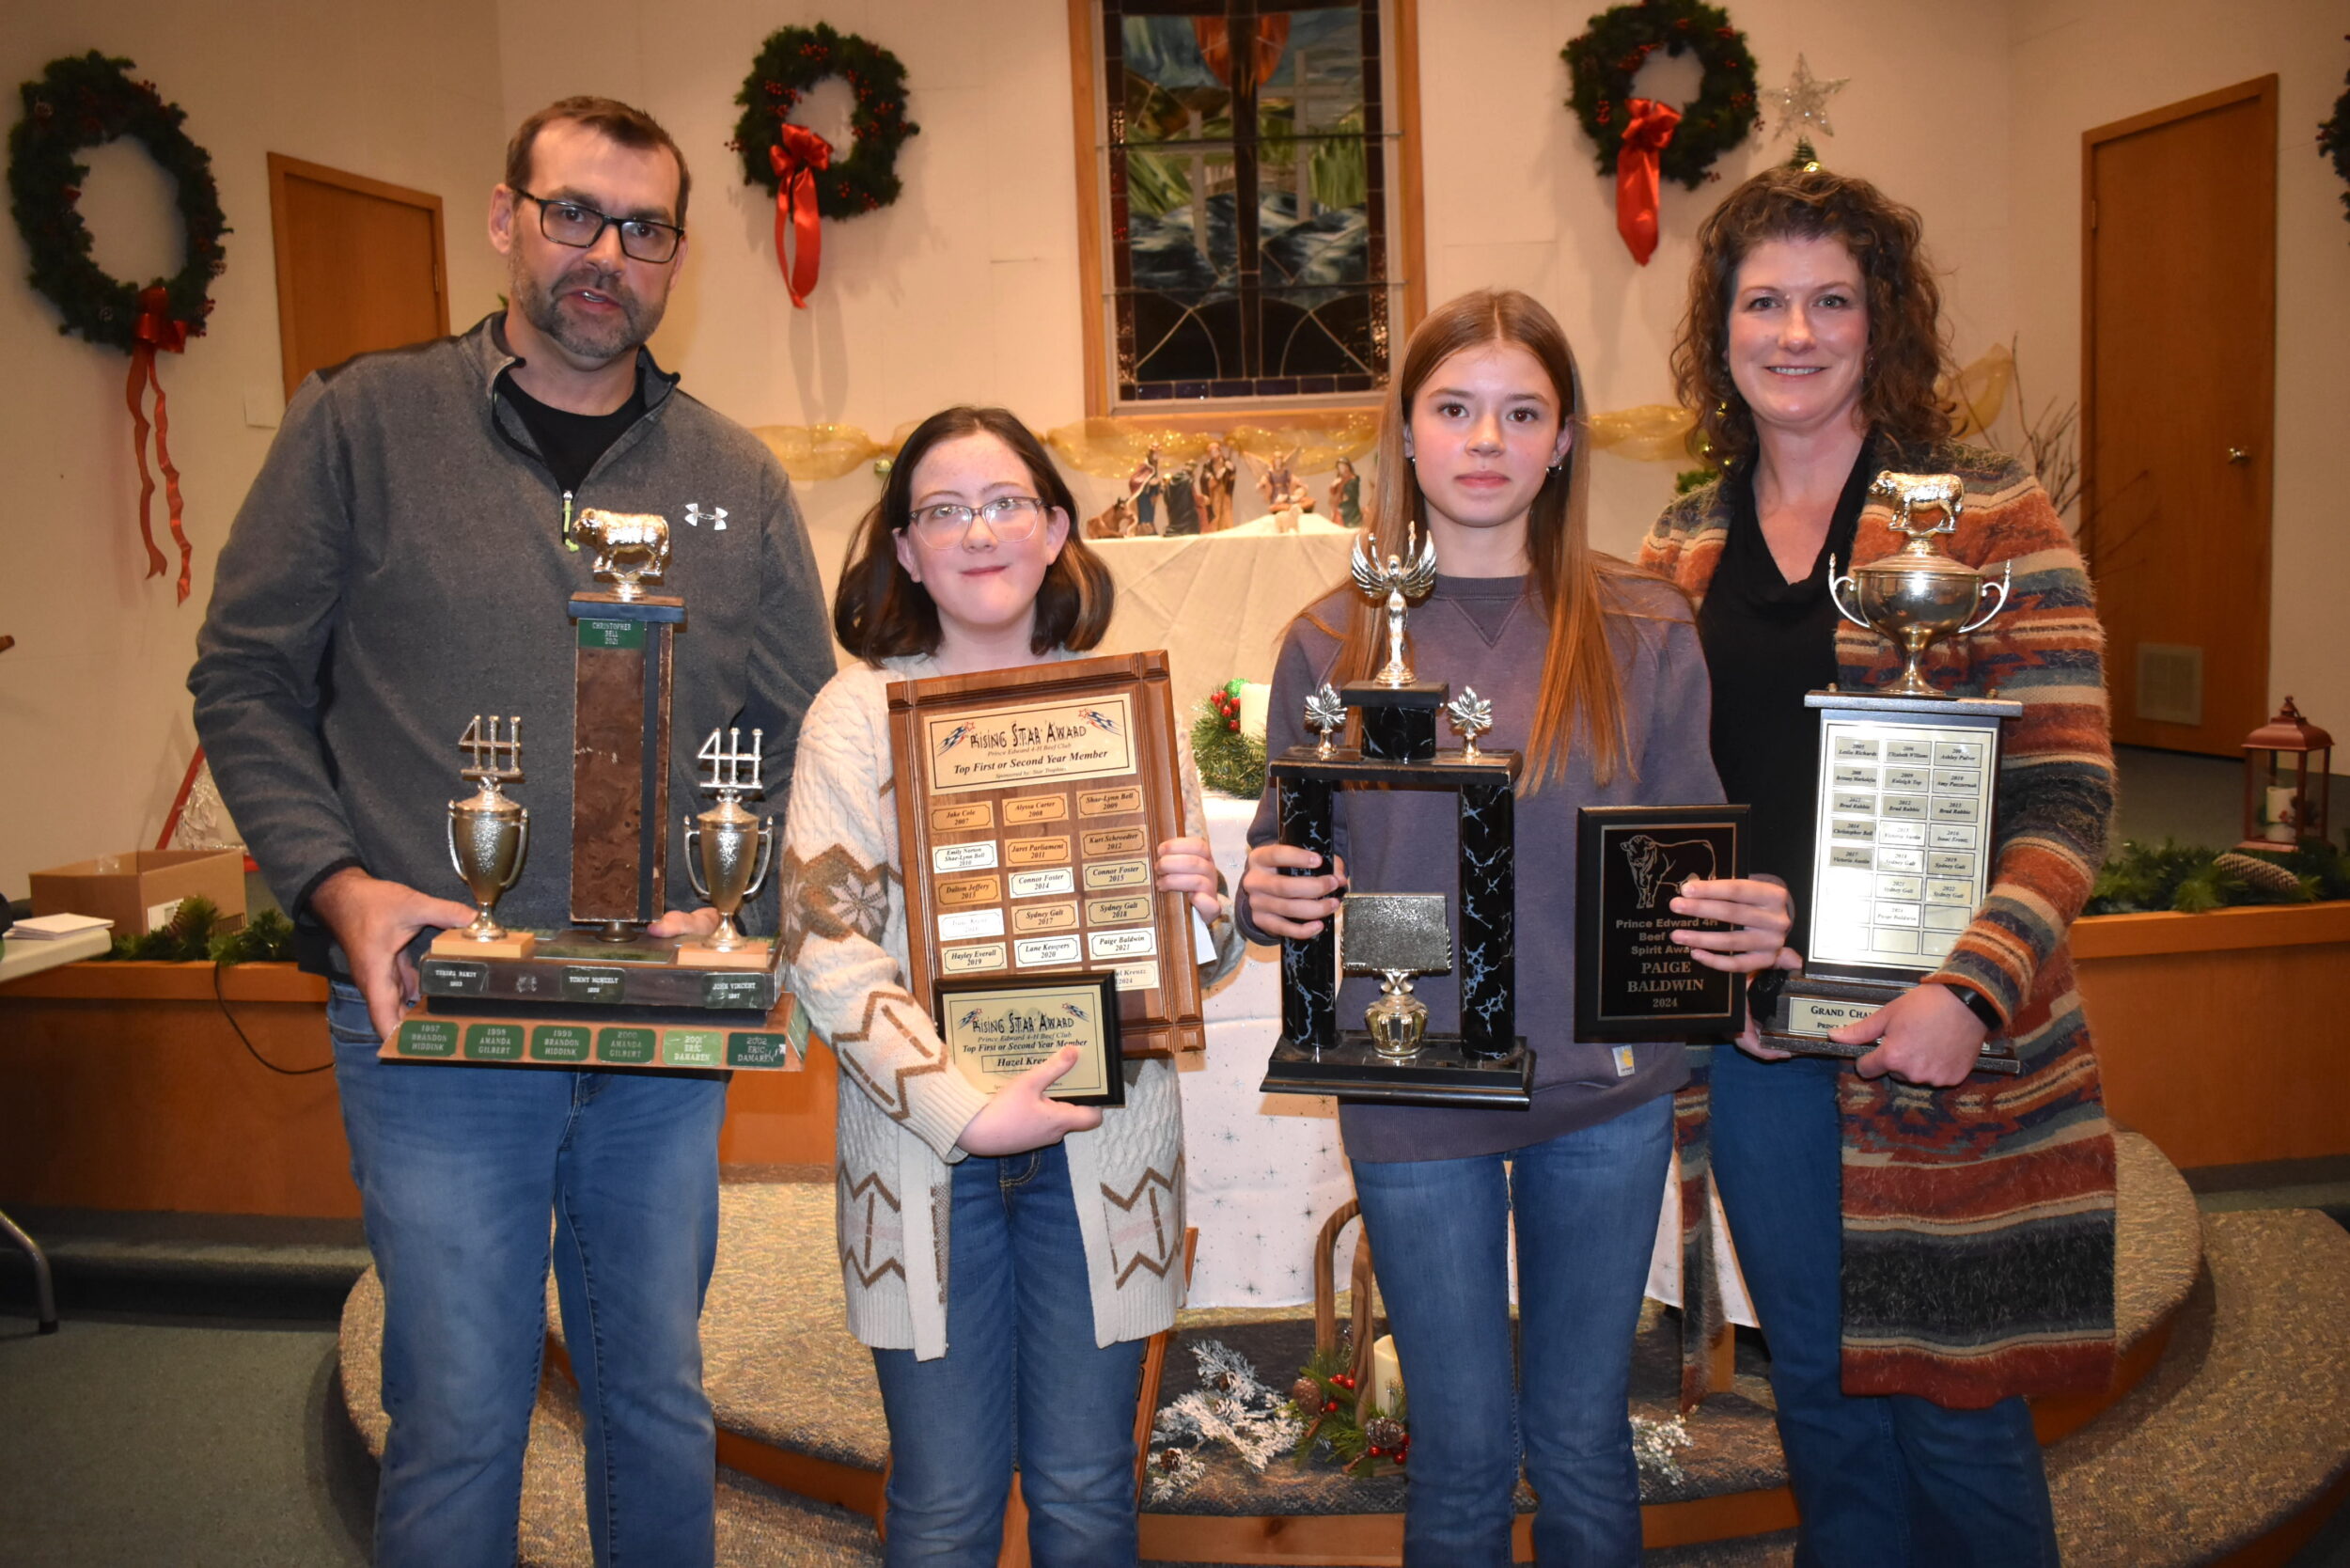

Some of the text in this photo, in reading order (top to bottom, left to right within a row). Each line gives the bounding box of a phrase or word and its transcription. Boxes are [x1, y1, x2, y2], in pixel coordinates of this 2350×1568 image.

[1010, 723, 1043, 747] STAR
[1046, 720, 1087, 743] AWARD
[1043, 744, 1058, 753] Beef
[1058, 742, 1072, 750] Club
[954, 764, 970, 776] Top
[973, 761, 995, 772] First
[1010, 757, 1043, 769] Second
[1046, 754, 1067, 764] Year
[1070, 750, 1108, 761] Member
[1029, 843, 1064, 852] Parliament
[968, 884, 990, 892] Jeffery
[1100, 903, 1122, 913] Sydney
[1026, 911, 1048, 920] Sydney
[1038, 917, 1054, 926] 2017
[1615, 918, 1653, 929] Prince
[1655, 917, 1700, 928] Edward
[1099, 937, 1118, 946] Paige
[1638, 932, 1667, 942] Beef
[1041, 950, 1057, 959] 2020
[1631, 945, 1663, 957] Spirit
[951, 952, 973, 961] Hayley
[966, 958, 982, 966] 2019
[1640, 961, 1692, 975] PAIGE
[1627, 979, 1705, 993] BALDWIN
[1653, 996, 1678, 1009] 2024
[1810, 1005, 1844, 1017] GRAND
[1009, 1011, 1035, 1034] STAR
[1038, 1011, 1074, 1031] AWARD
[412, 1033, 447, 1043] BRANDON
[479, 1037, 511, 1045] AMANDA
[684, 1035, 703, 1043] 2001
[746, 1037, 767, 1045] 2002
[1041, 1032, 1056, 1041] Beef
[544, 1038, 579, 1046] BRANDON
[610, 1040, 642, 1048] AMANDA
[963, 1044, 977, 1054] Top
[979, 1043, 996, 1052] First
[1009, 1042, 1036, 1050] Second
[1038, 1040, 1055, 1048] Year
[1056, 1039, 1088, 1047] Member
[412, 1043, 445, 1051] HIDDINK
[478, 1045, 510, 1054] GILBERT
[544, 1047, 577, 1056] HIDDINK
[684, 1043, 701, 1053] ERIC
[997, 1057, 1024, 1067] Hazel
